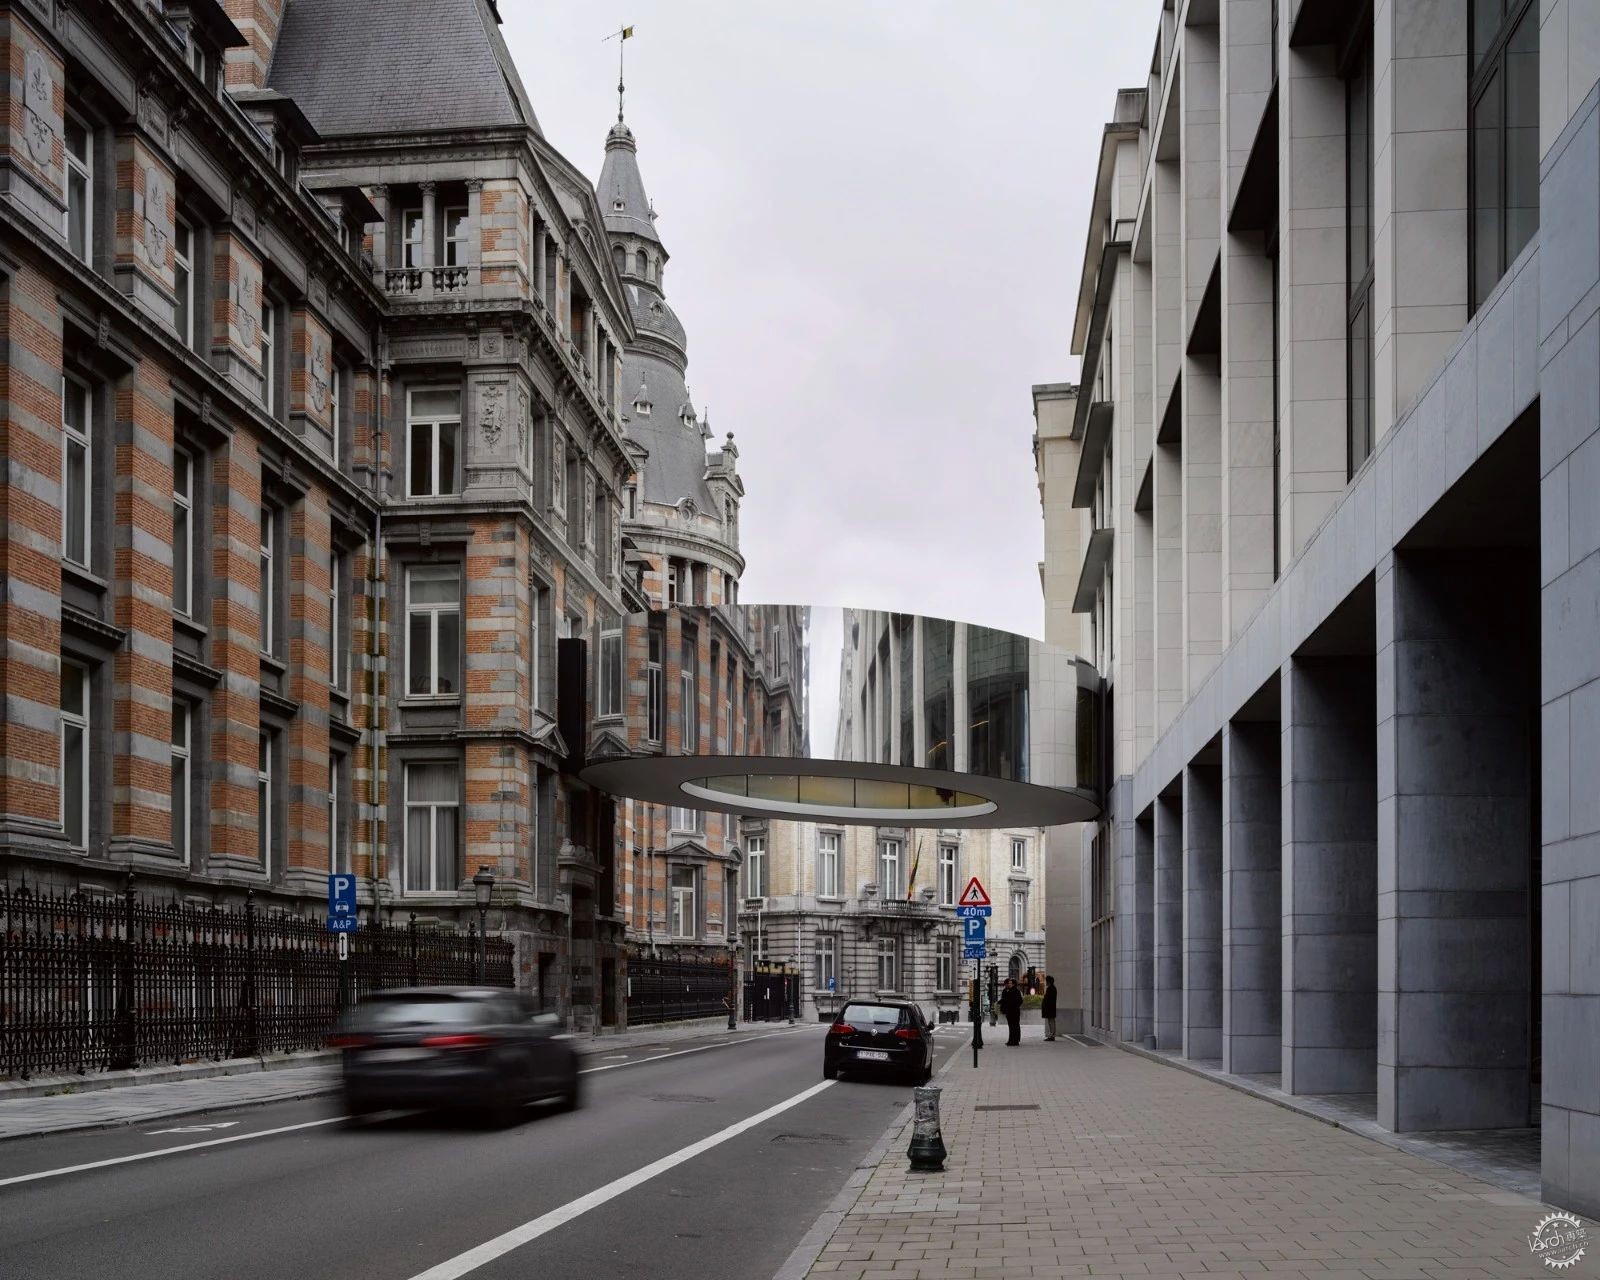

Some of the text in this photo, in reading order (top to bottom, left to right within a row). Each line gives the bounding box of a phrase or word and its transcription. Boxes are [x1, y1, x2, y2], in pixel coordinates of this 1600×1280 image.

[335, 877, 349, 899] P
[963, 907, 986, 916] 40m
[333, 920, 352, 929] A&P
[969, 920, 980, 936] P
